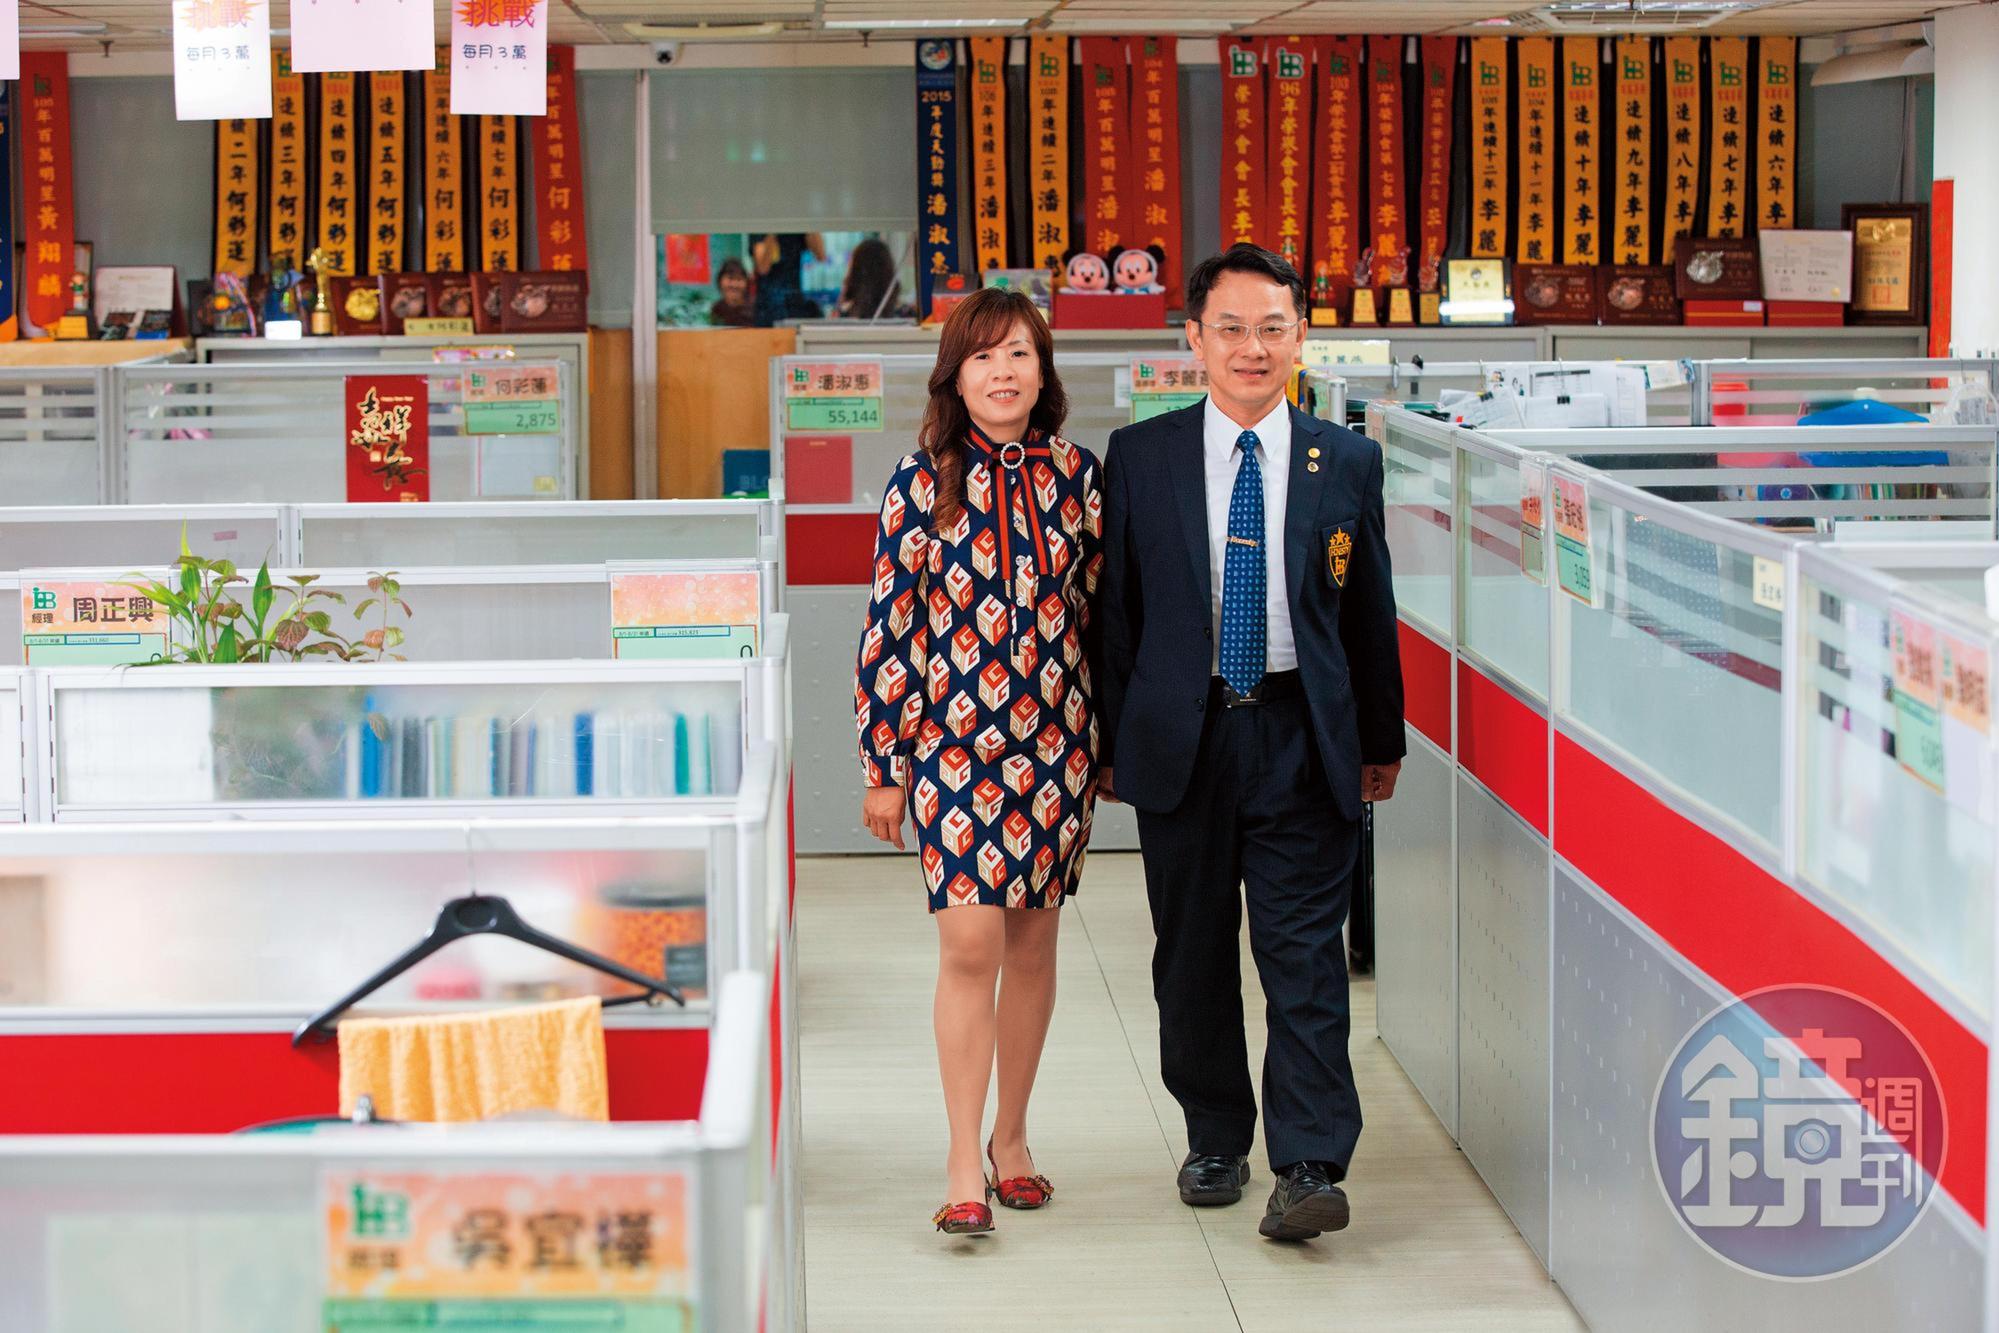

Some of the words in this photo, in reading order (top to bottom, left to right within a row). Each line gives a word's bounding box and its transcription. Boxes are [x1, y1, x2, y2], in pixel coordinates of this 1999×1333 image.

[466, 0, 535, 28] 挑戰
[1232, 83, 1253, 243] 榮譽會會長李
[1573, 105, 1594, 264] 連續十年李麗
[515, 413, 556, 428] 2,875
[828, 410, 878, 424] 55,144
[73, 597, 154, 623] 周正興
